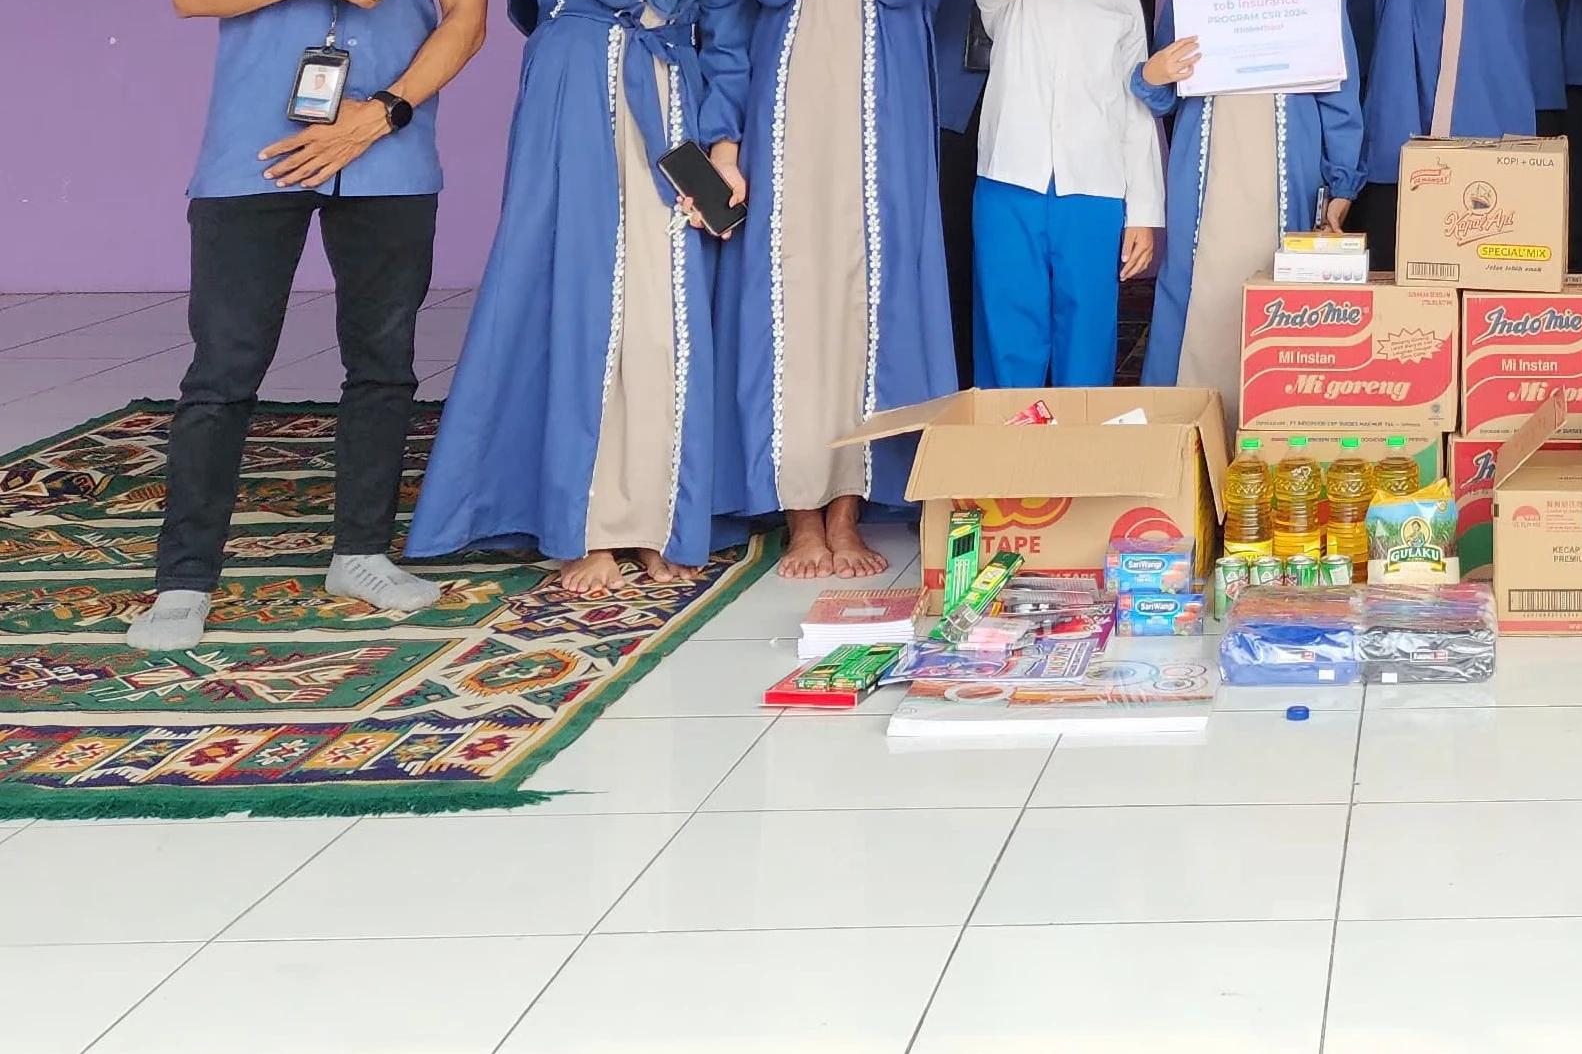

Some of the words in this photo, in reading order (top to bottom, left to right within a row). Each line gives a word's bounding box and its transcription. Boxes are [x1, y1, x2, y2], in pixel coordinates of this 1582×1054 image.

[1207, 12, 1260, 25] PROGRAM
[1496, 156, 1520, 166] KOPI
[1528, 158, 1554, 167] GULA
[1481, 245, 1524, 258] SPECIAL
[1525, 247, 1547, 259] MIX
[1296, 350, 1336, 365] Instan
[1519, 358, 1558, 372] Instan
[1284, 374, 1325, 395] Mi
[1324, 379, 1411, 401] goreng
[1507, 380, 1548, 403] Mi
[981, 536, 1041, 554] TAPE
[1552, 546, 1580, 554] KECAP
[1390, 546, 1439, 562] GULAKU
